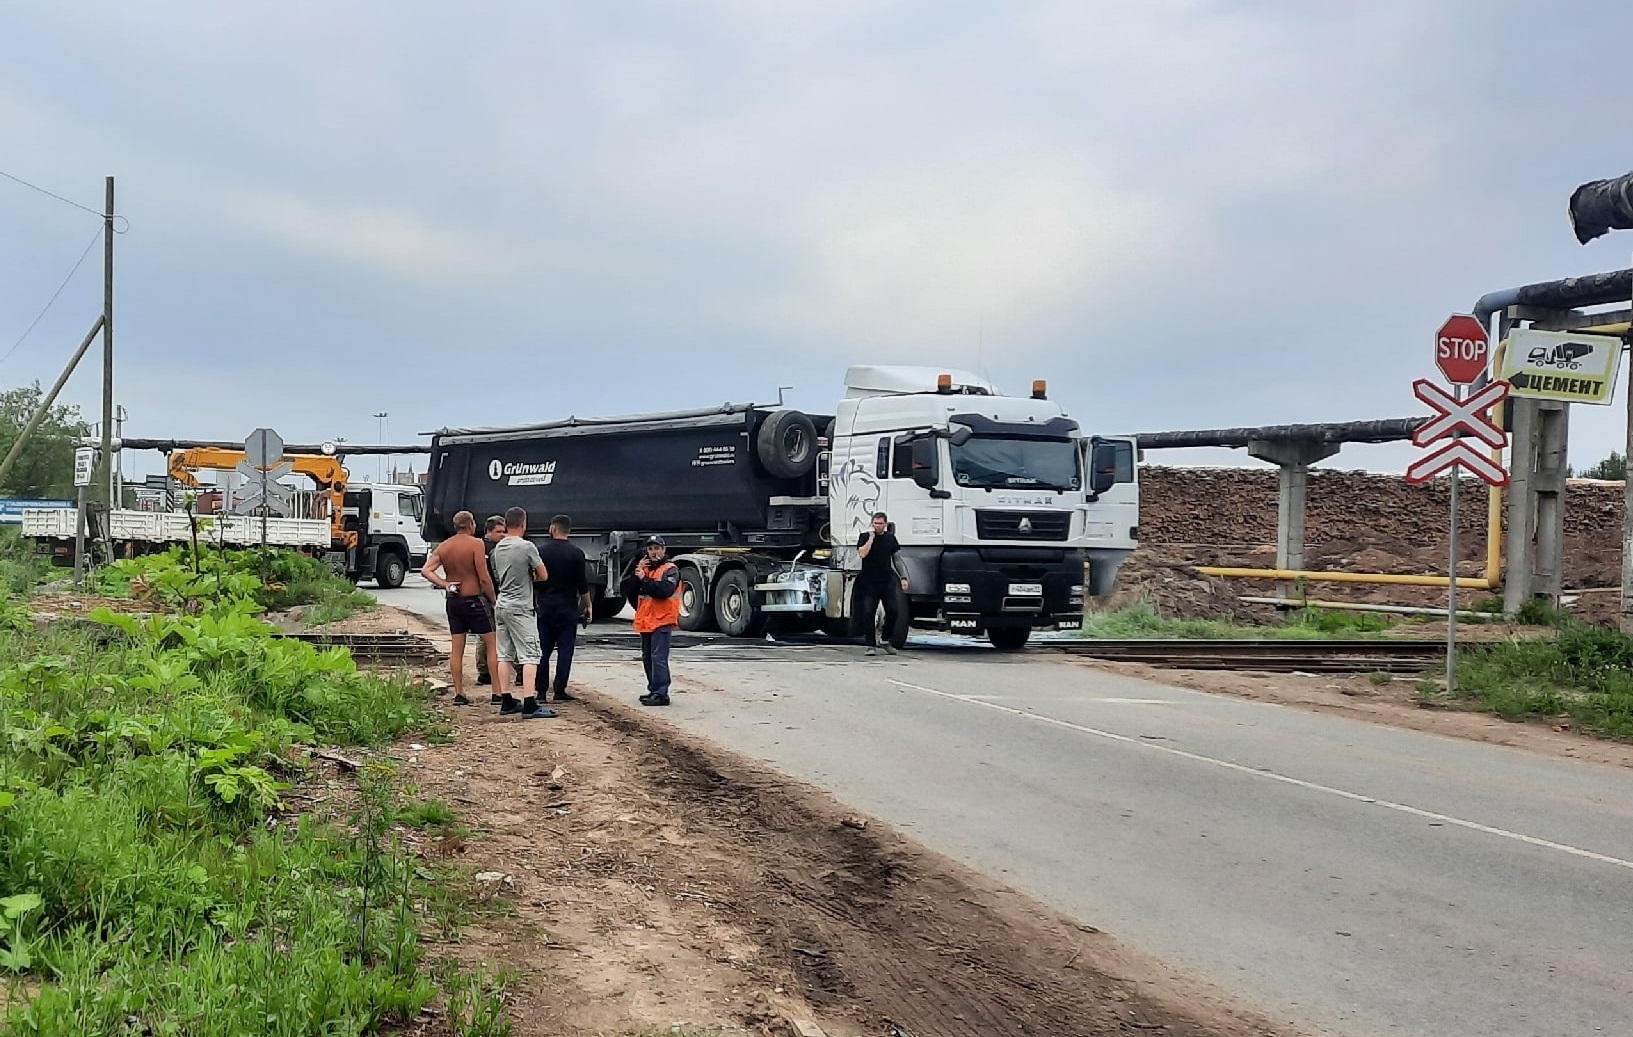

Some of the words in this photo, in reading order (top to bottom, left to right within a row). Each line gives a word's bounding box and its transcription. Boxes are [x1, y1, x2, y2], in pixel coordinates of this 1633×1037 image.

[1438, 336, 1488, 362] STOP
[1530, 373, 1605, 396] ЦЕМЕНТ
[950, 619, 977, 628] MAN
